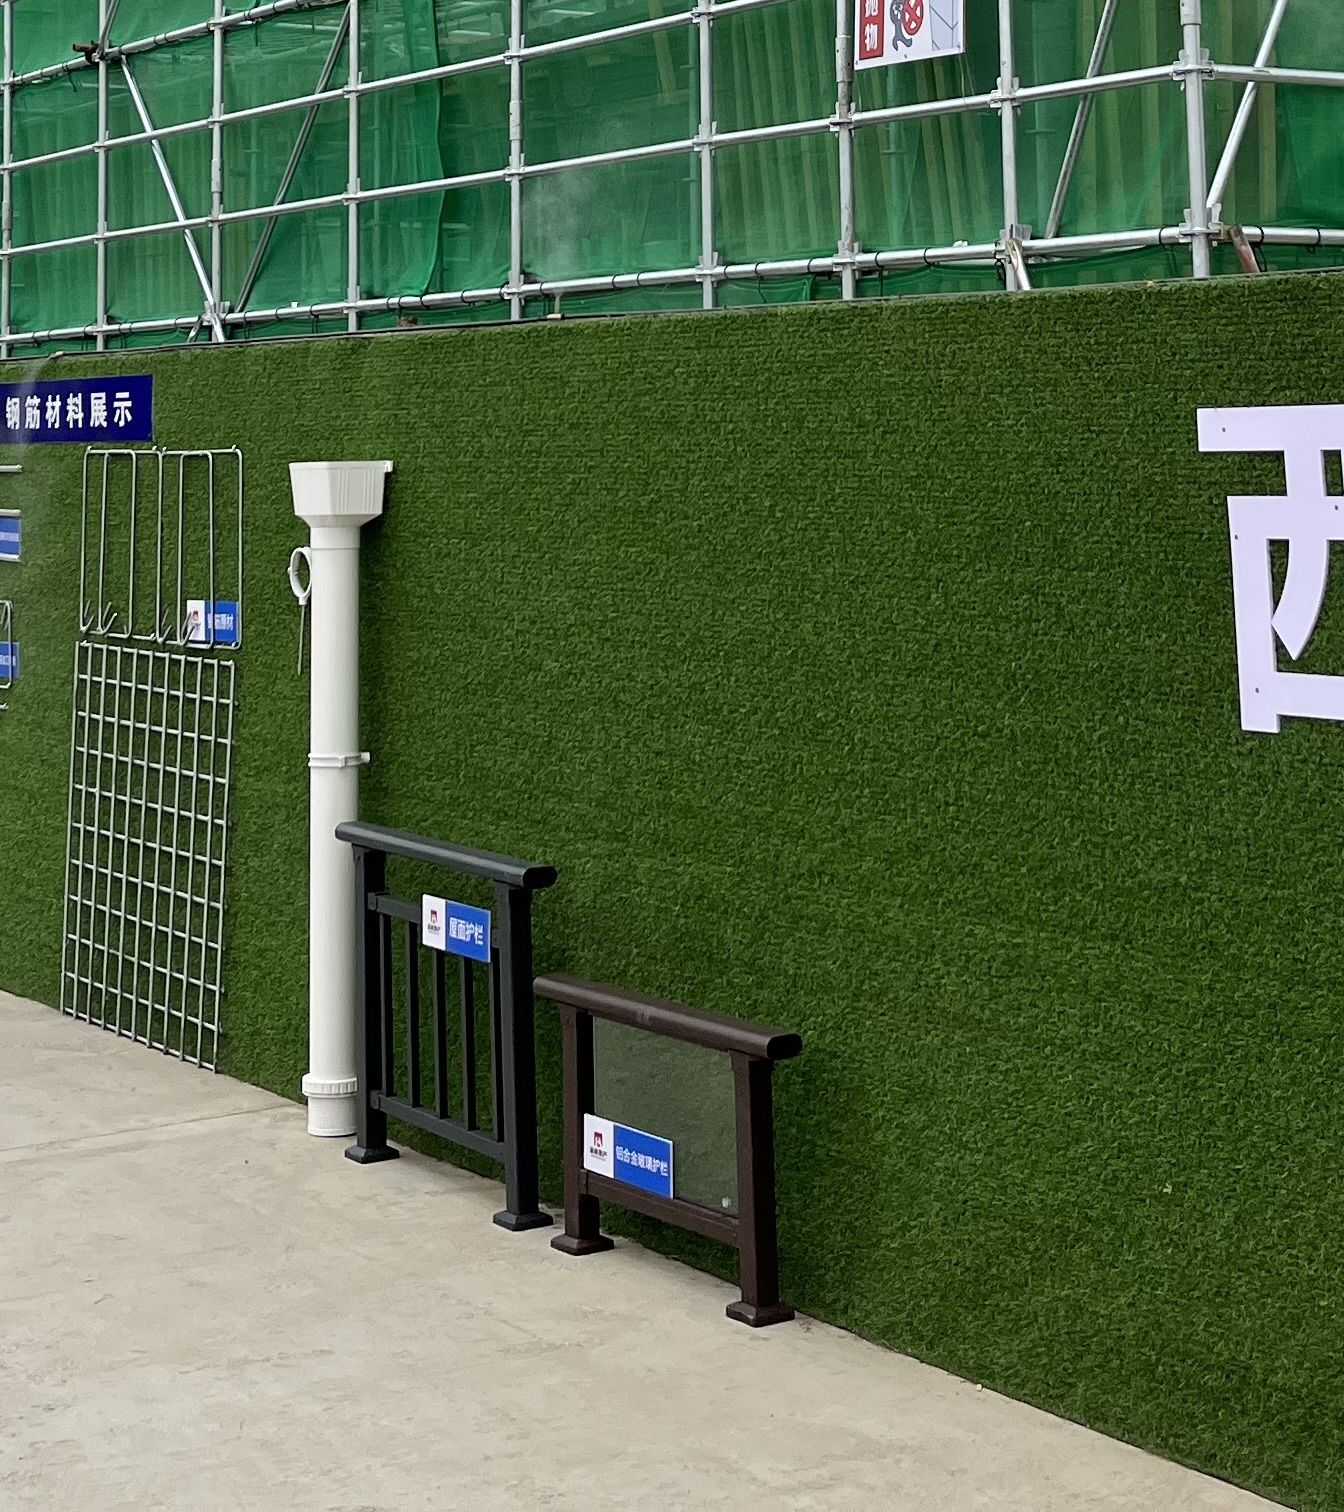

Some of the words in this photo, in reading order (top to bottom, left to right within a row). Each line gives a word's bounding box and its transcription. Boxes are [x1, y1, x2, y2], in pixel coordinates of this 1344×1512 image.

[5, 391, 133, 431] 钢筋材料展示
[448, 916, 484, 946] 屋面护栏
[615, 1145, 669, 1177] 铝合金玻璃护栏
